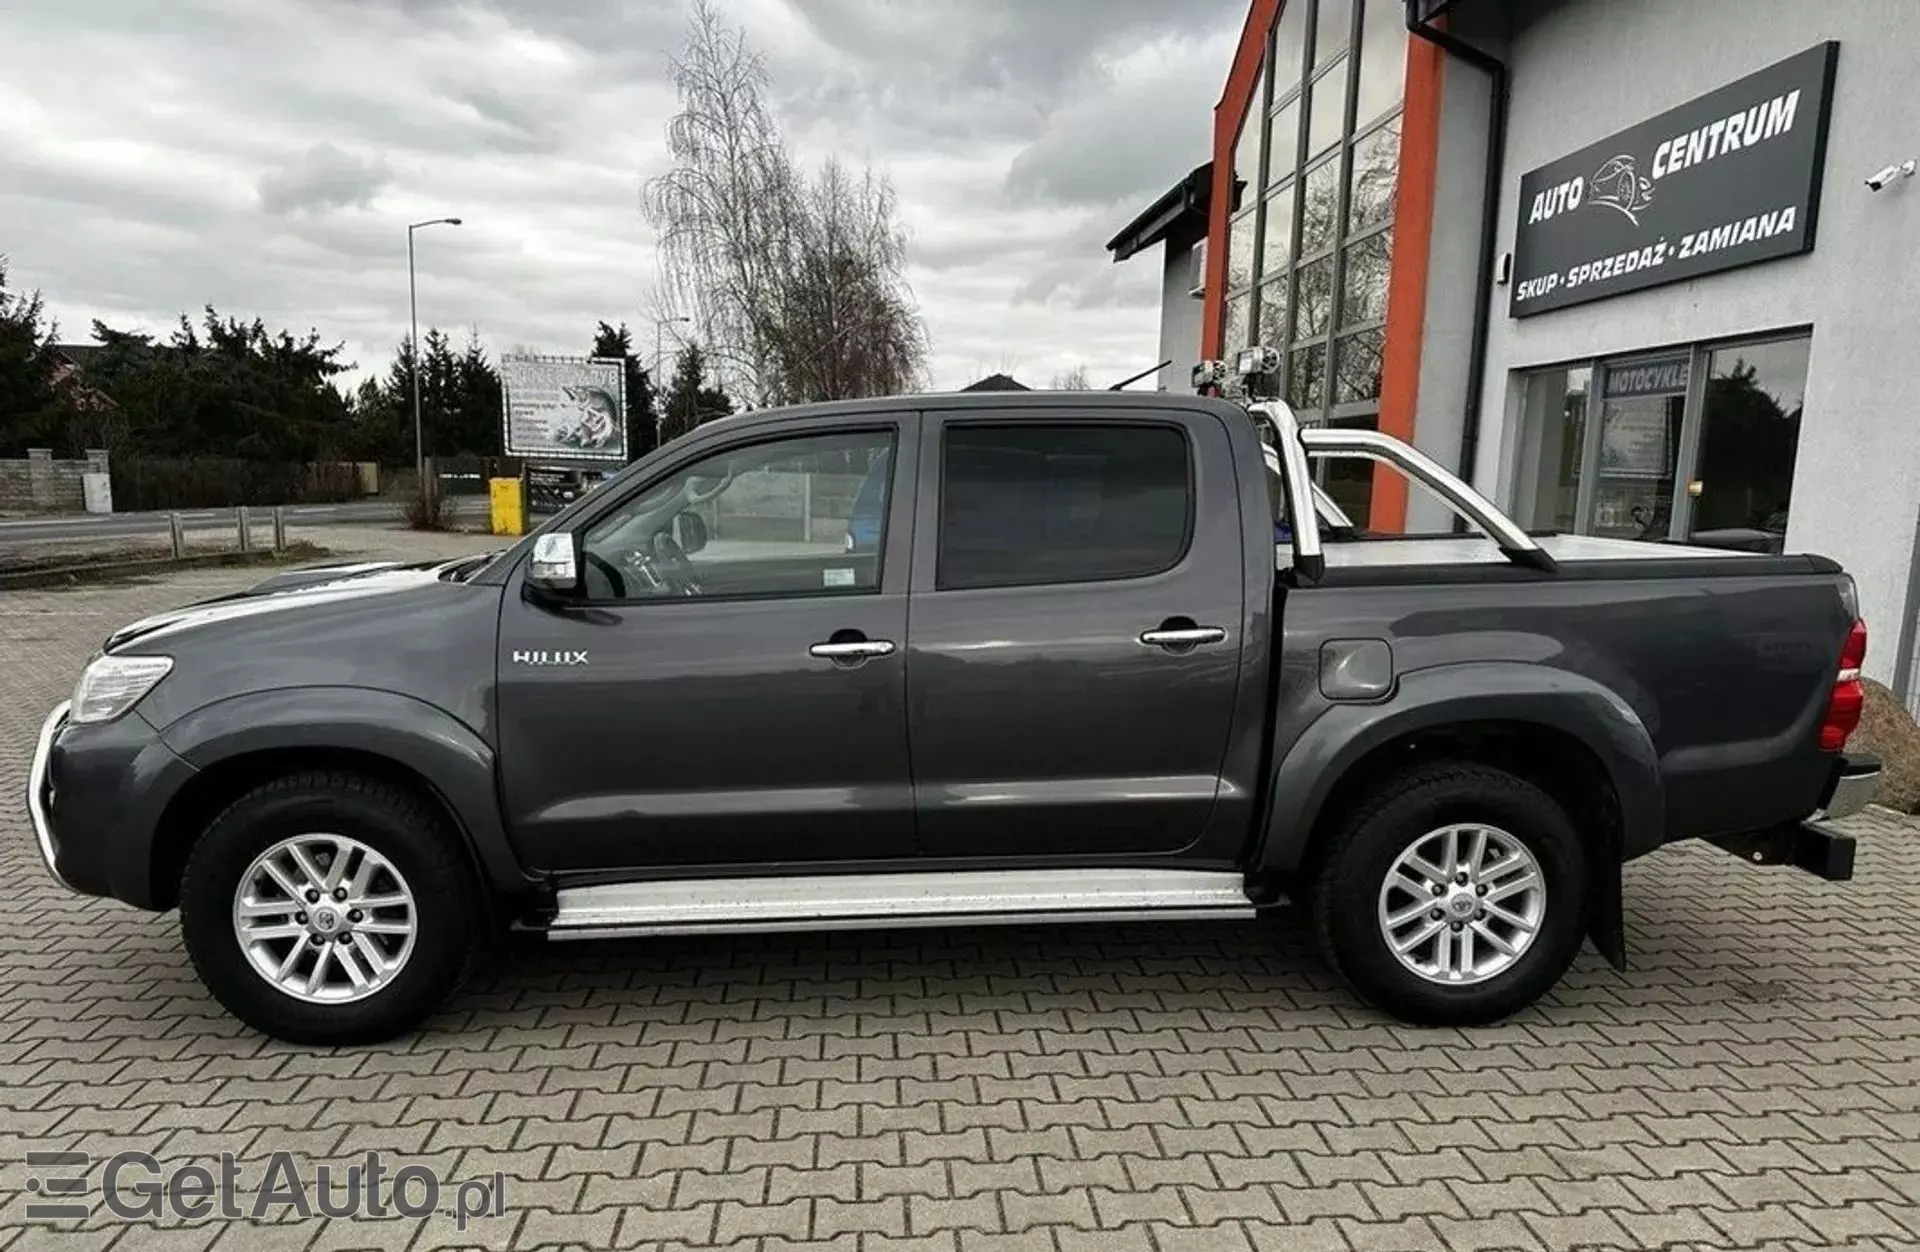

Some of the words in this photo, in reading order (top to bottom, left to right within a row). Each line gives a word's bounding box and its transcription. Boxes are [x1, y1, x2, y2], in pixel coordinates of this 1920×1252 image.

[1528, 176, 1584, 224] AUTO
[1651, 89, 1800, 181] CENTRUM
[1516, 271, 1557, 301] SKUP
[1565, 236, 1667, 289] SPRZEDAŻ
[1678, 206, 1796, 260] ZAMIANA
[1608, 363, 1689, 392] MOTOCYKLE
[513, 650, 590, 665] HILUX
